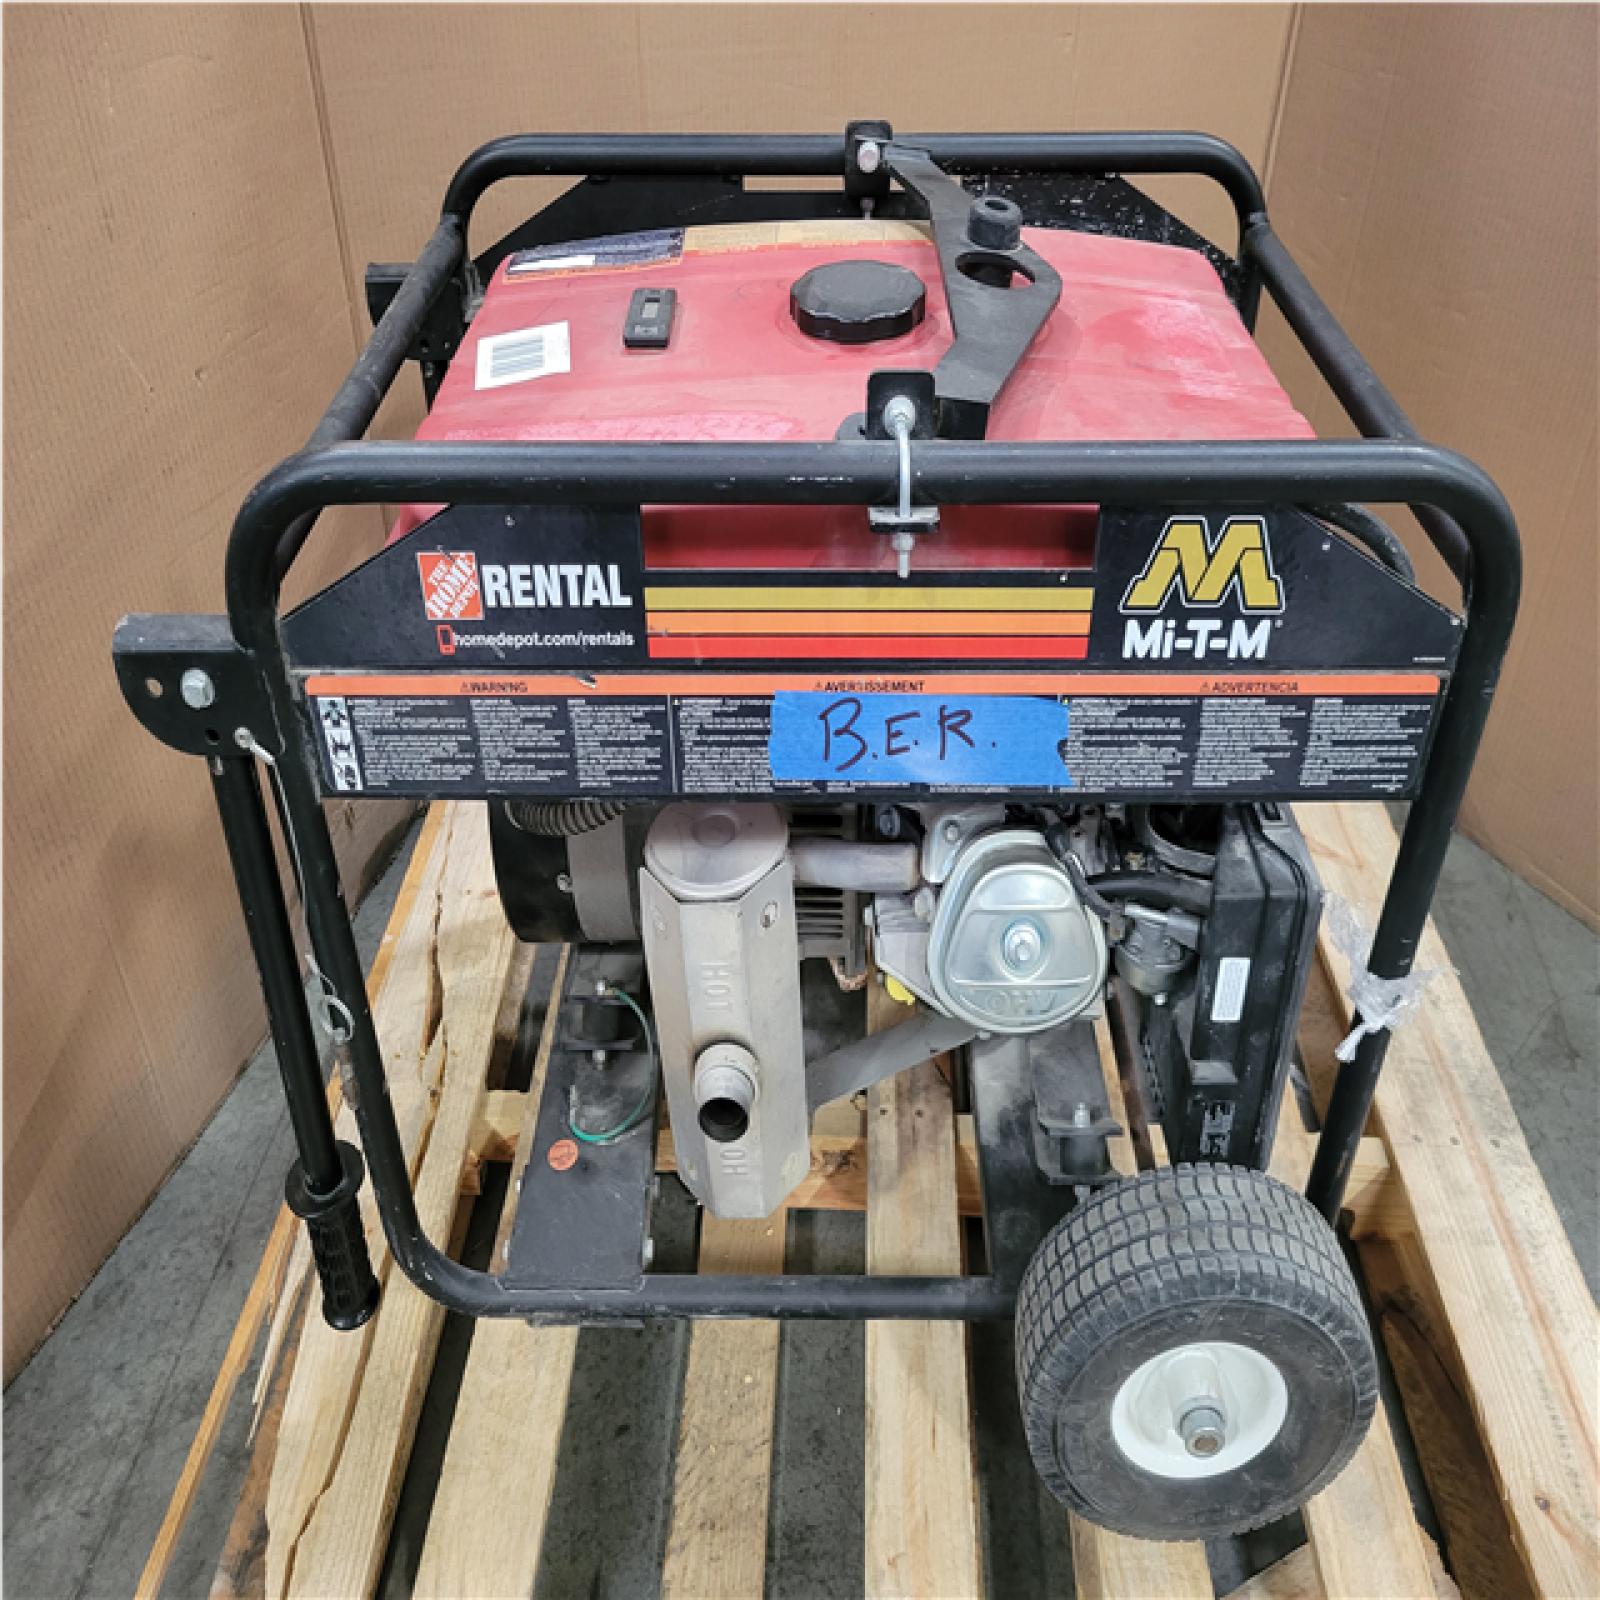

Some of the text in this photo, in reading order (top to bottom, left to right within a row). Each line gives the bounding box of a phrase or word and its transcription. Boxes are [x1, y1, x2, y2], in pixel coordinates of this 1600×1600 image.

[426, 553, 476, 618] HOME
[482, 564, 633, 607] RENTAL
[454, 631, 635, 649] homedepot.com/rentals
[1121, 619, 1273, 660] Mi-T-M
[470, 681, 528, 694] WARNING
[824, 680, 925, 693] AVERTISSEMENT
[1212, 681, 1299, 693] ADVERTENCIA
